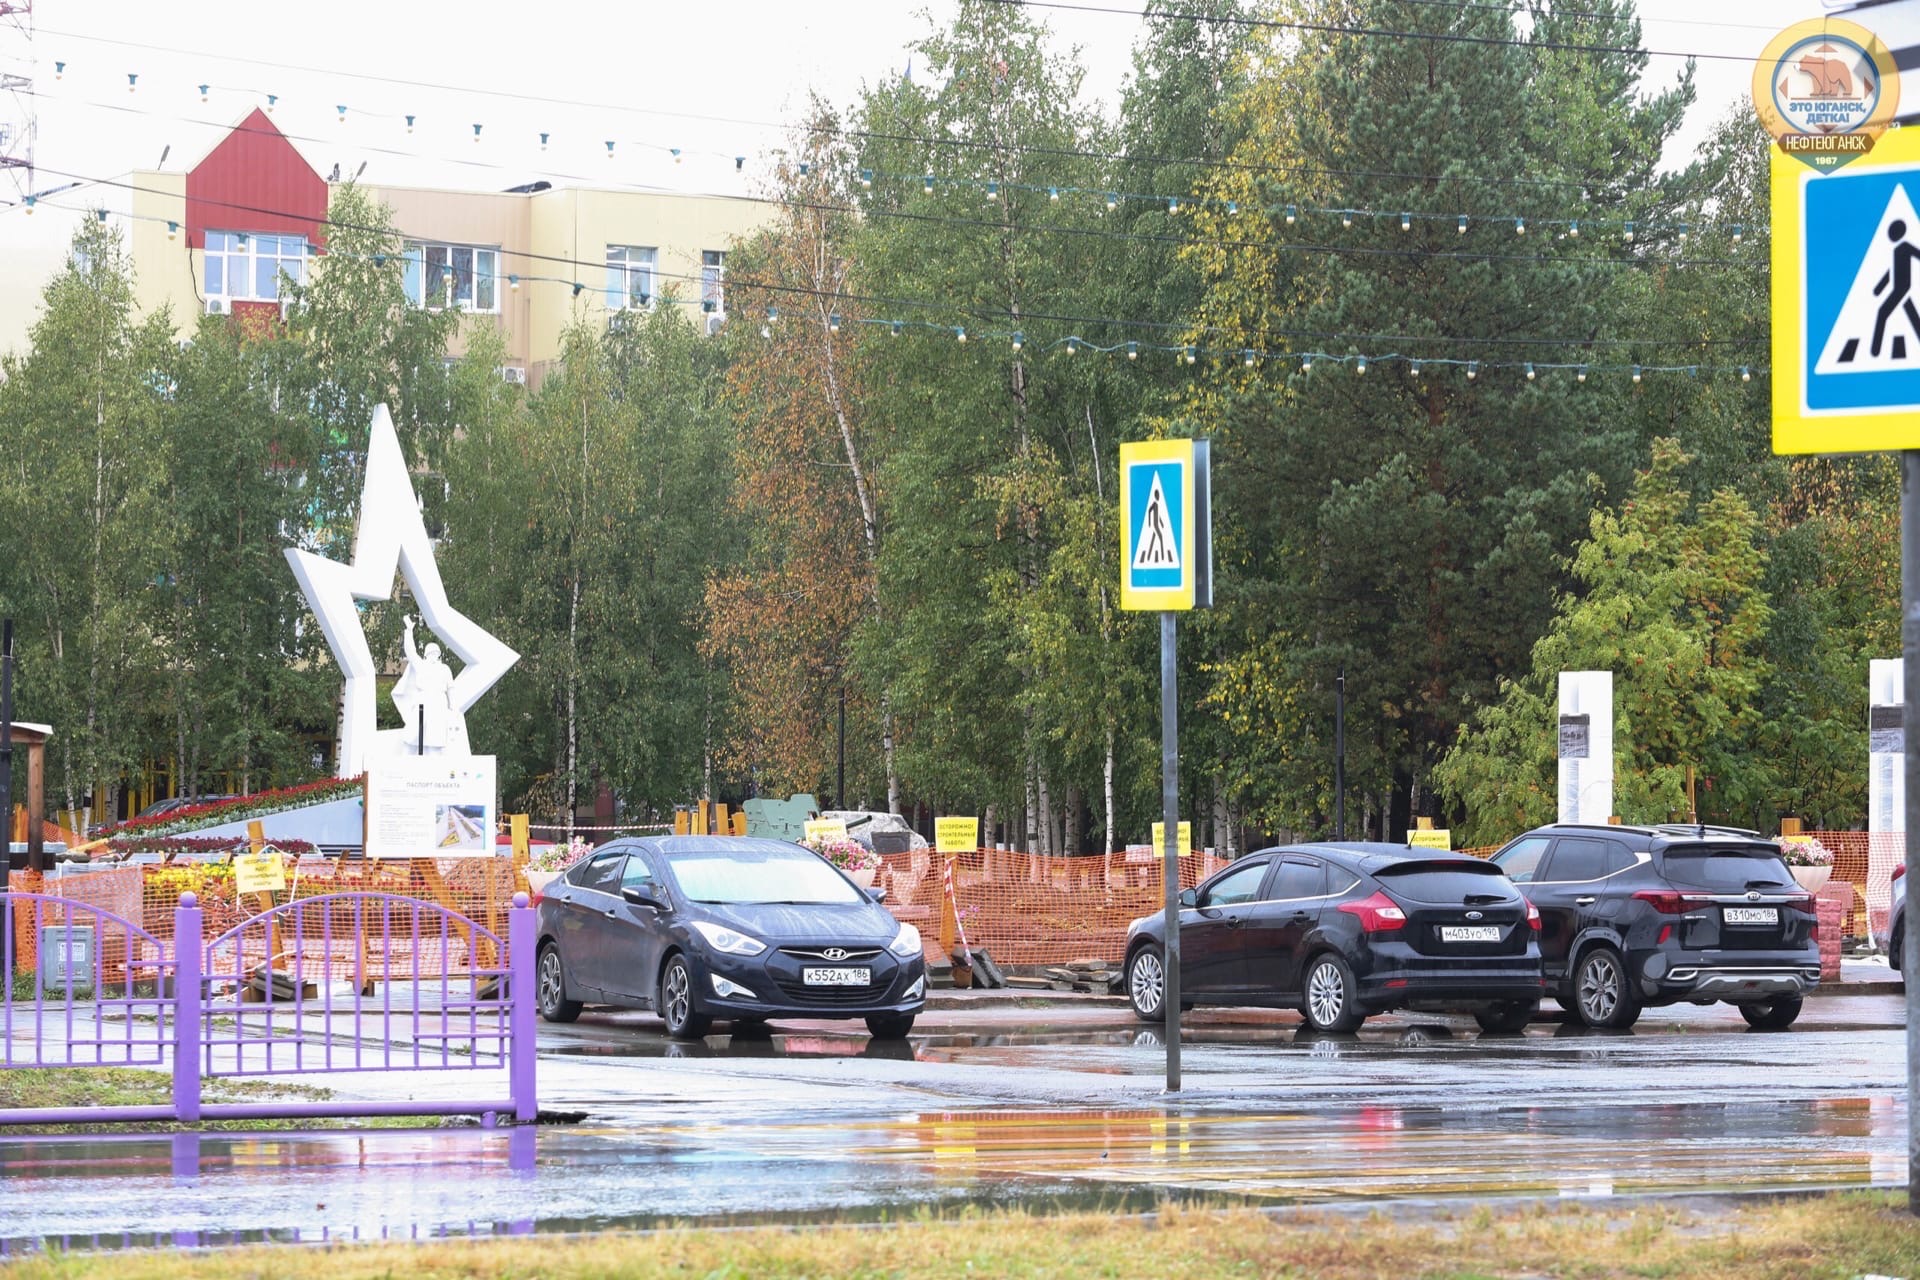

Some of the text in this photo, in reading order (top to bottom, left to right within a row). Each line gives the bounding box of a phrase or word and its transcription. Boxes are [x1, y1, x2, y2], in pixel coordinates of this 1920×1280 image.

[939, 823, 974, 831] ОСТОРОЖНО!
[937, 831, 976, 839] СТРОИТЕЛЬНЫЕ
[1727, 909, 1762, 920] В310МО
[1445, 928, 1497, 940] М403УО 190
[807, 969, 868, 982] К552АХ 186
